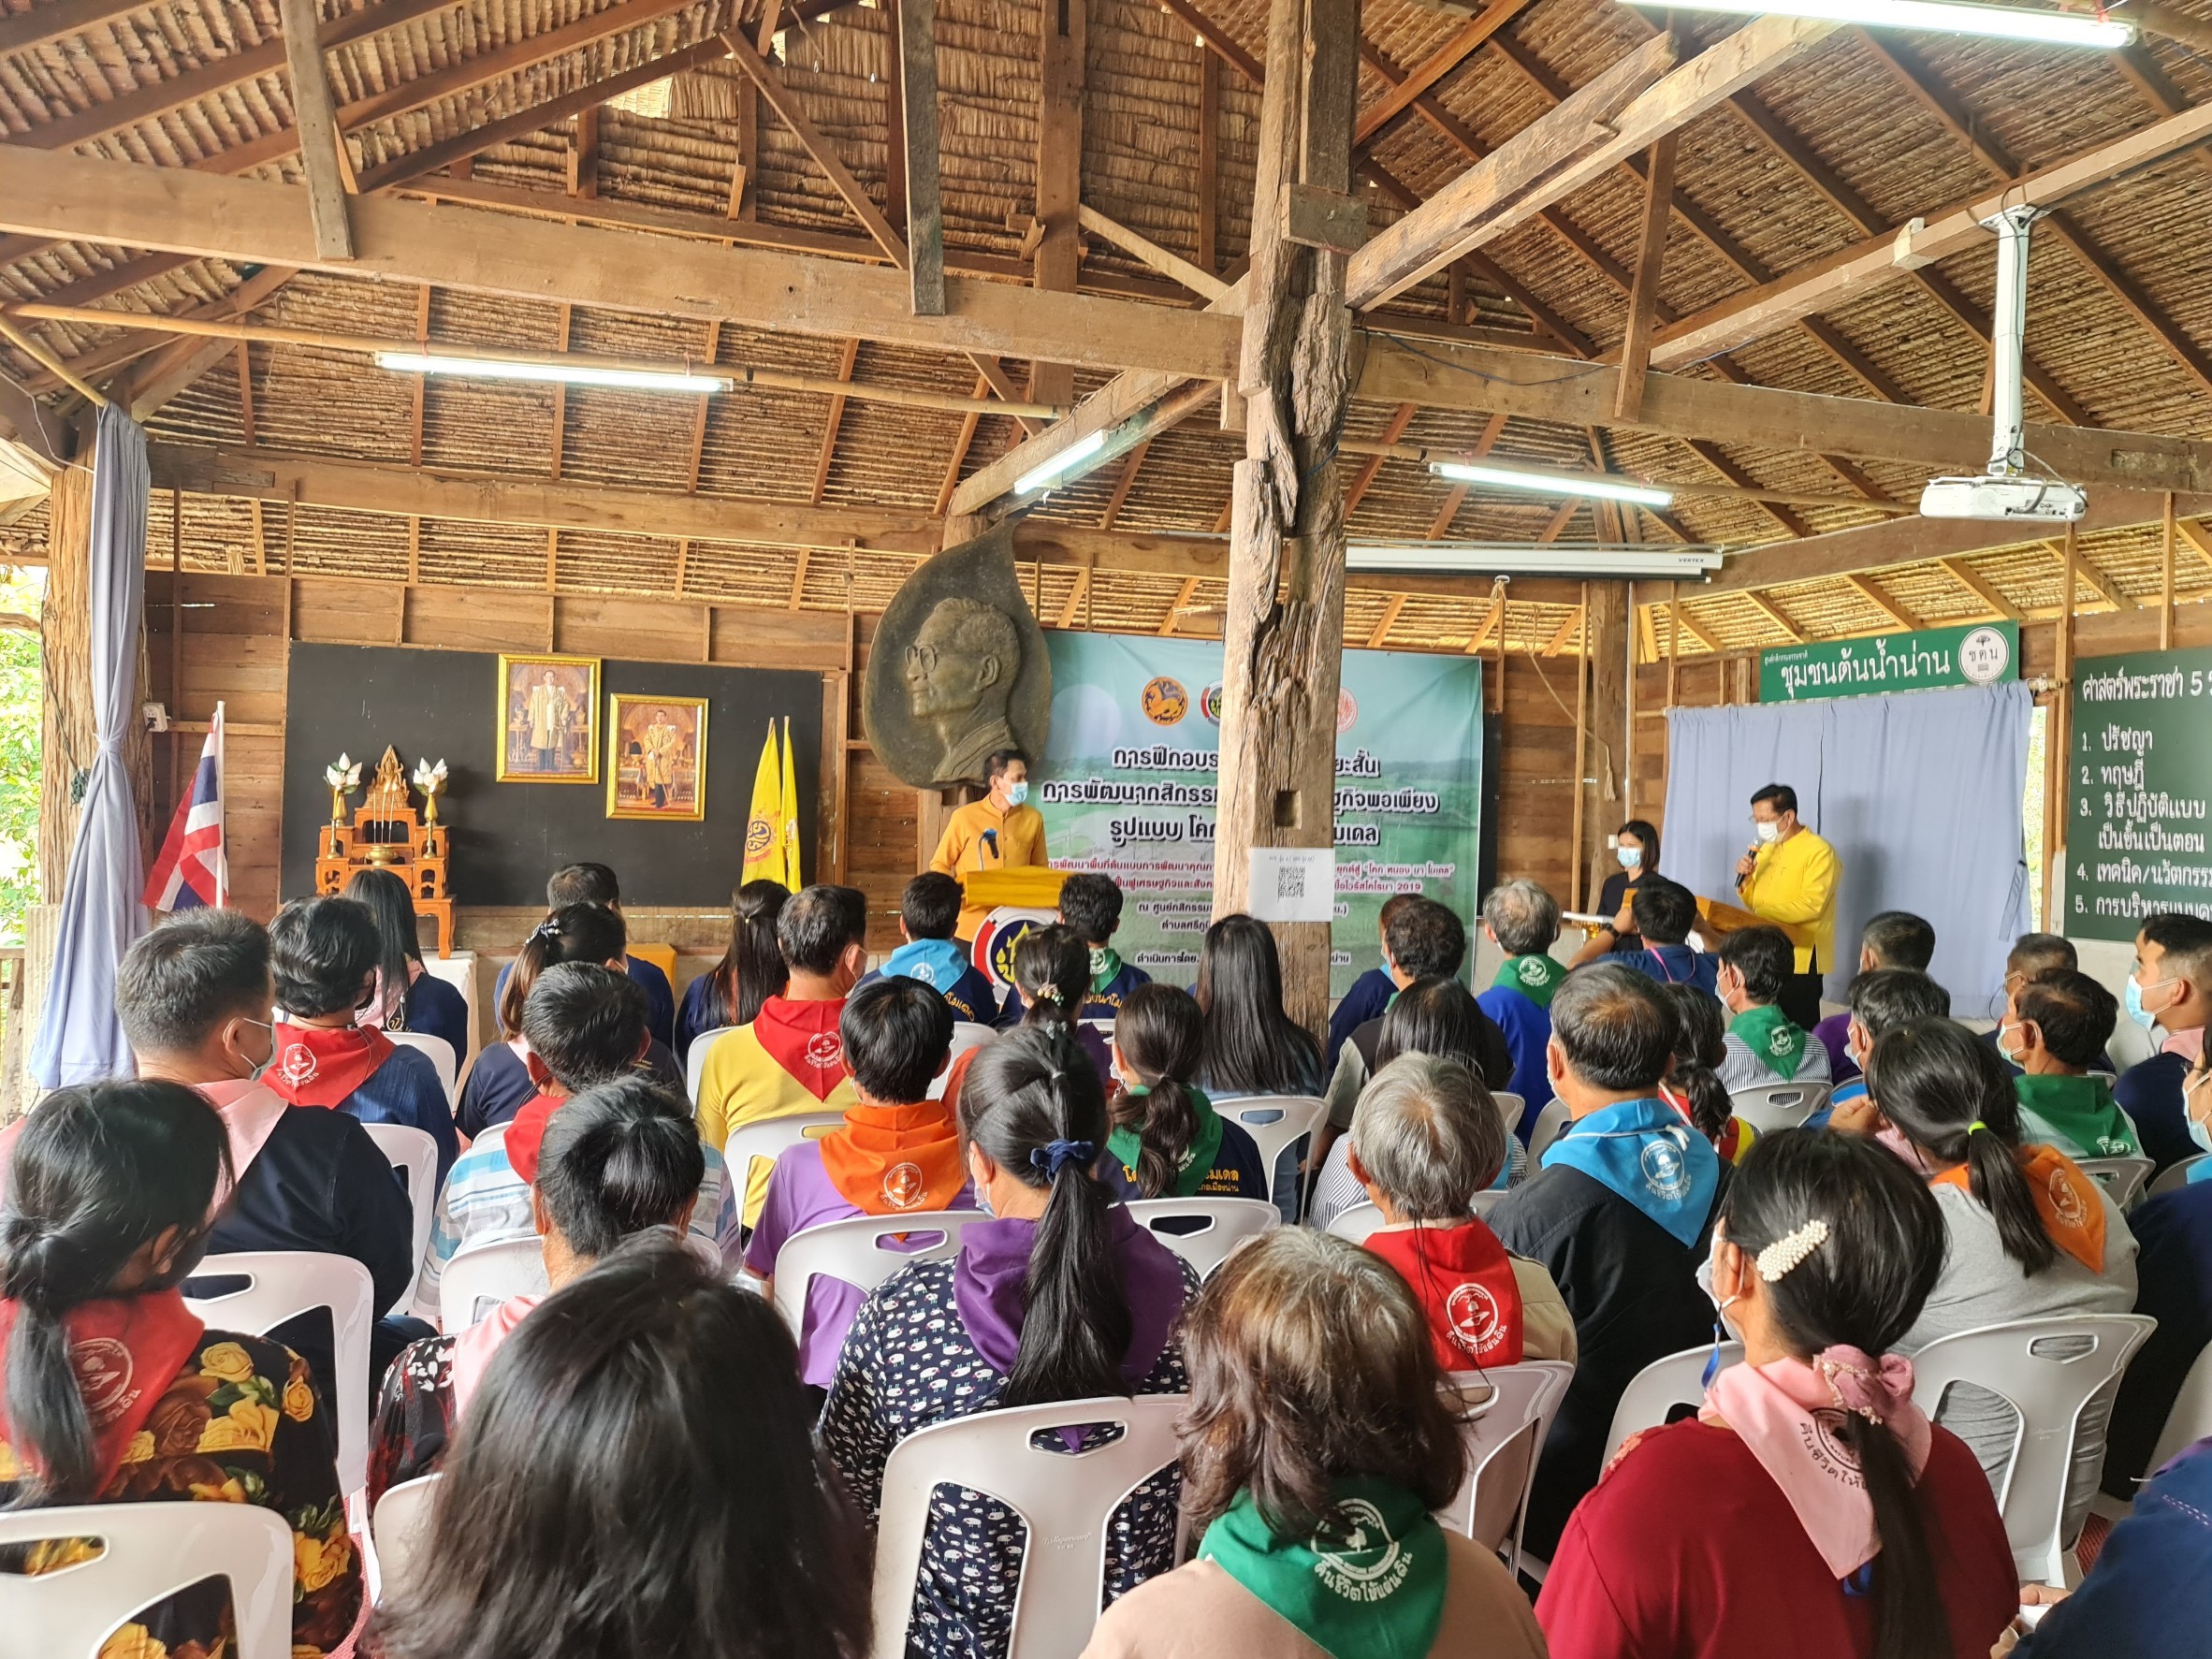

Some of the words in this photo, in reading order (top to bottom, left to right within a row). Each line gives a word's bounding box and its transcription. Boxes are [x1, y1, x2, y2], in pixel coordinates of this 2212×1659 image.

[1781, 637, 1951, 699] ชุมชนต้นน้ำน่าน
[2082, 665, 2184, 702] ศาสตร์พระราชา
[2190, 670, 2203, 696] 5
[2102, 722, 2153, 757] ปรัชญา
[1042, 779, 1217, 805] การพัฒนากสิกรร
[1397, 881, 1421, 891] 2019
[1314, 1552, 1413, 1602] คืนชีวิตให้แผ่นดิน
